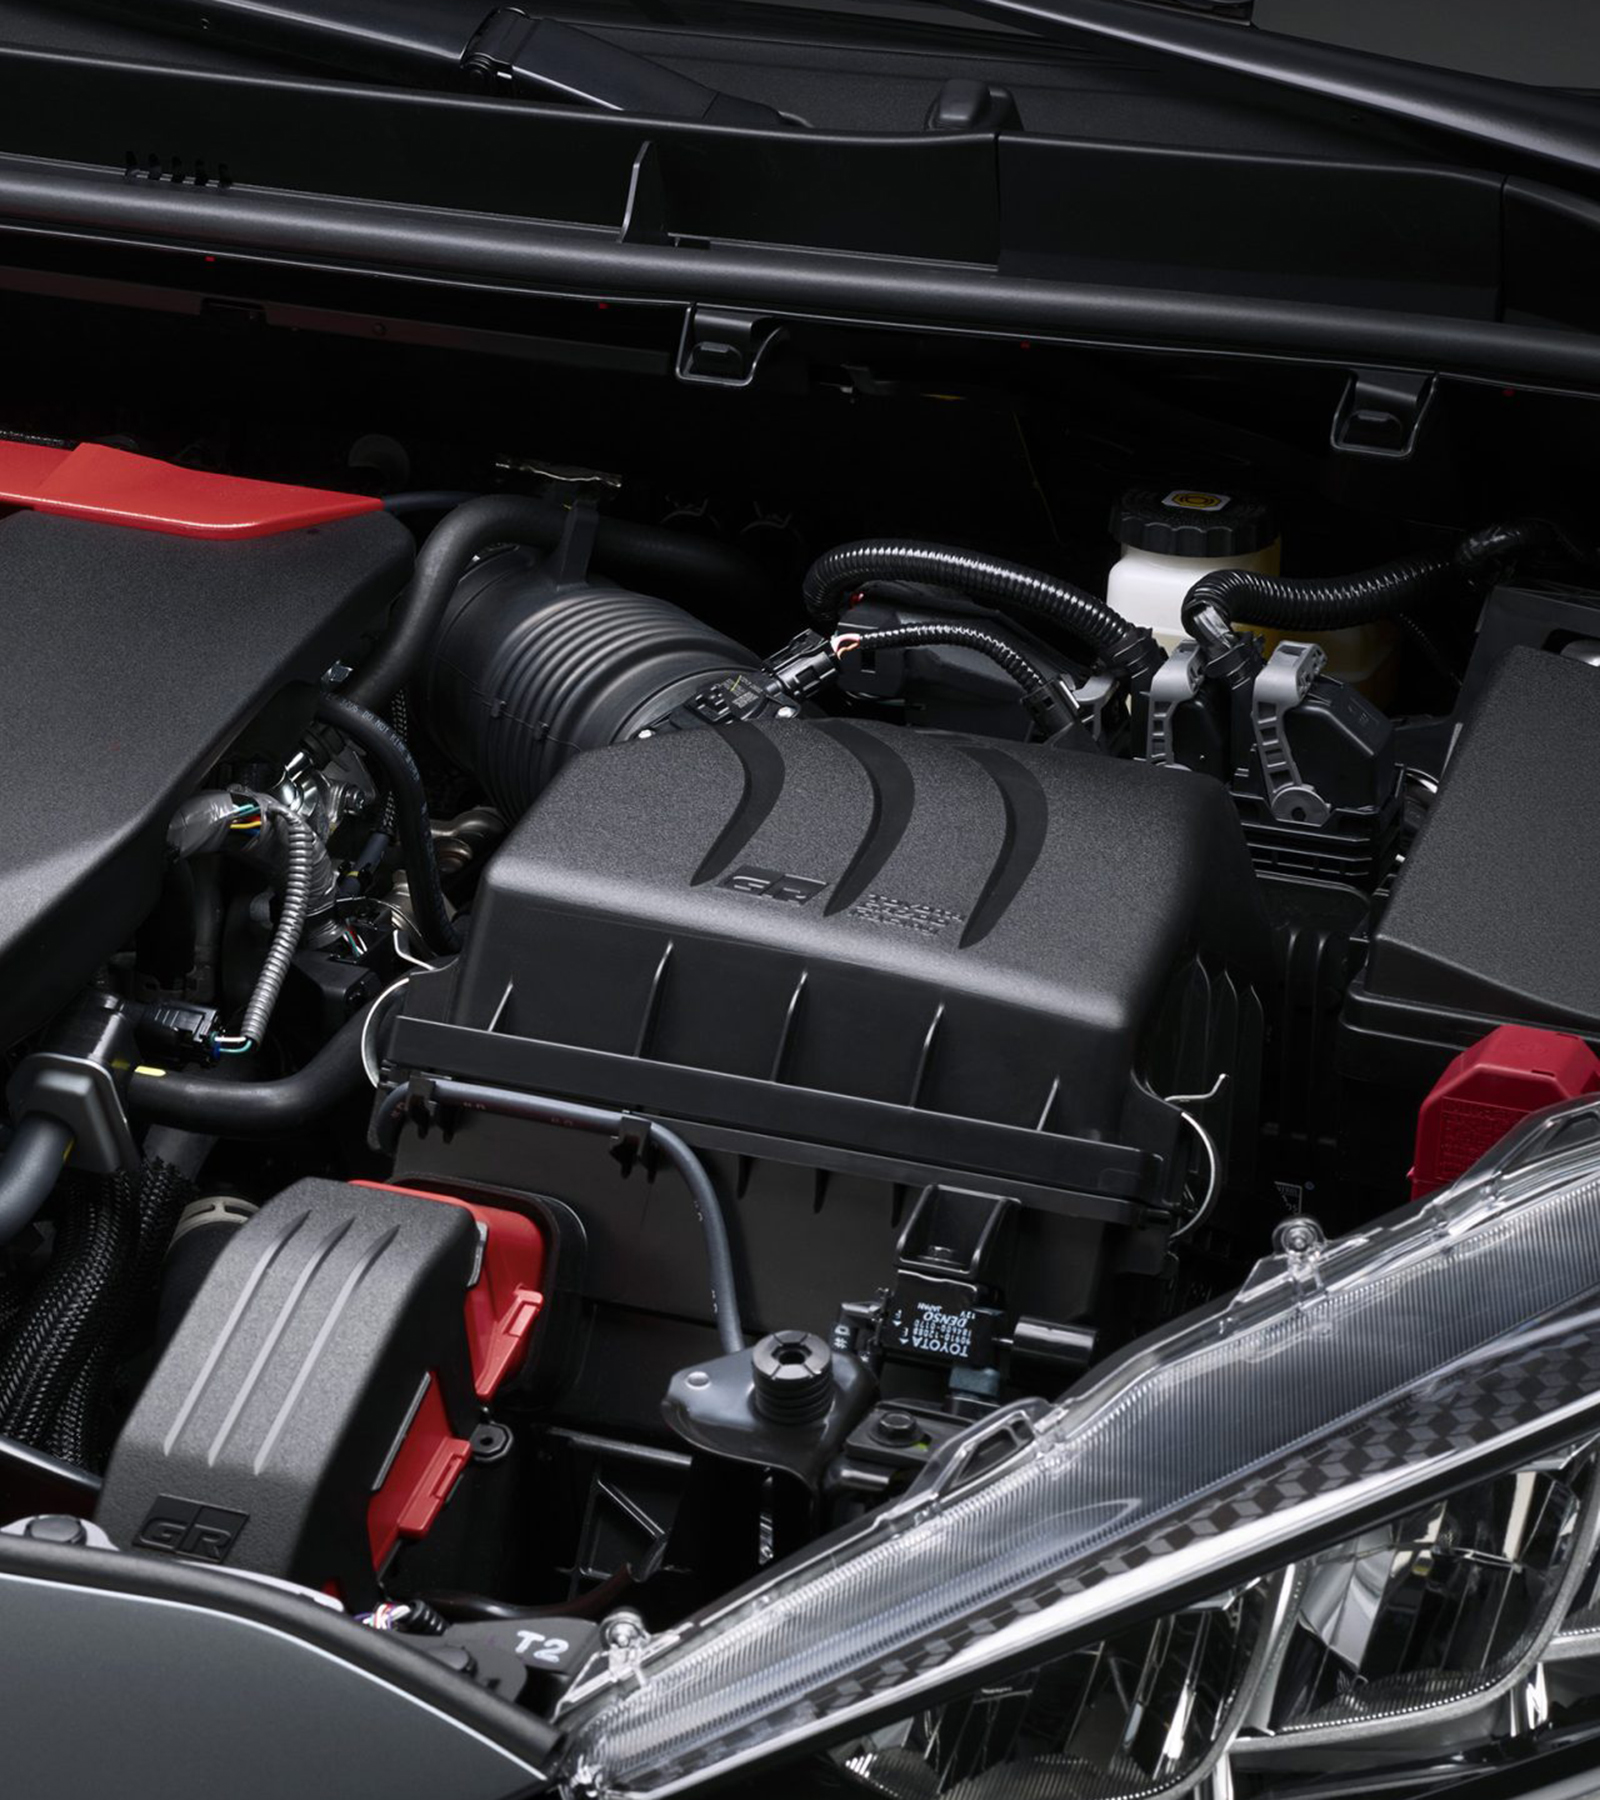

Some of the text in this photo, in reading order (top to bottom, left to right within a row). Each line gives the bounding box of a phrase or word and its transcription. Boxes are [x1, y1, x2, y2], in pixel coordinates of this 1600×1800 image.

[721, 872, 828, 906] GR
[916, 1301, 943, 1313] JAPAN
[922, 1310, 968, 1328] DENSO
[911, 1335, 969, 1358] TOYOTA
[138, 1515, 235, 1563] GR
[514, 1629, 570, 1664] T2
